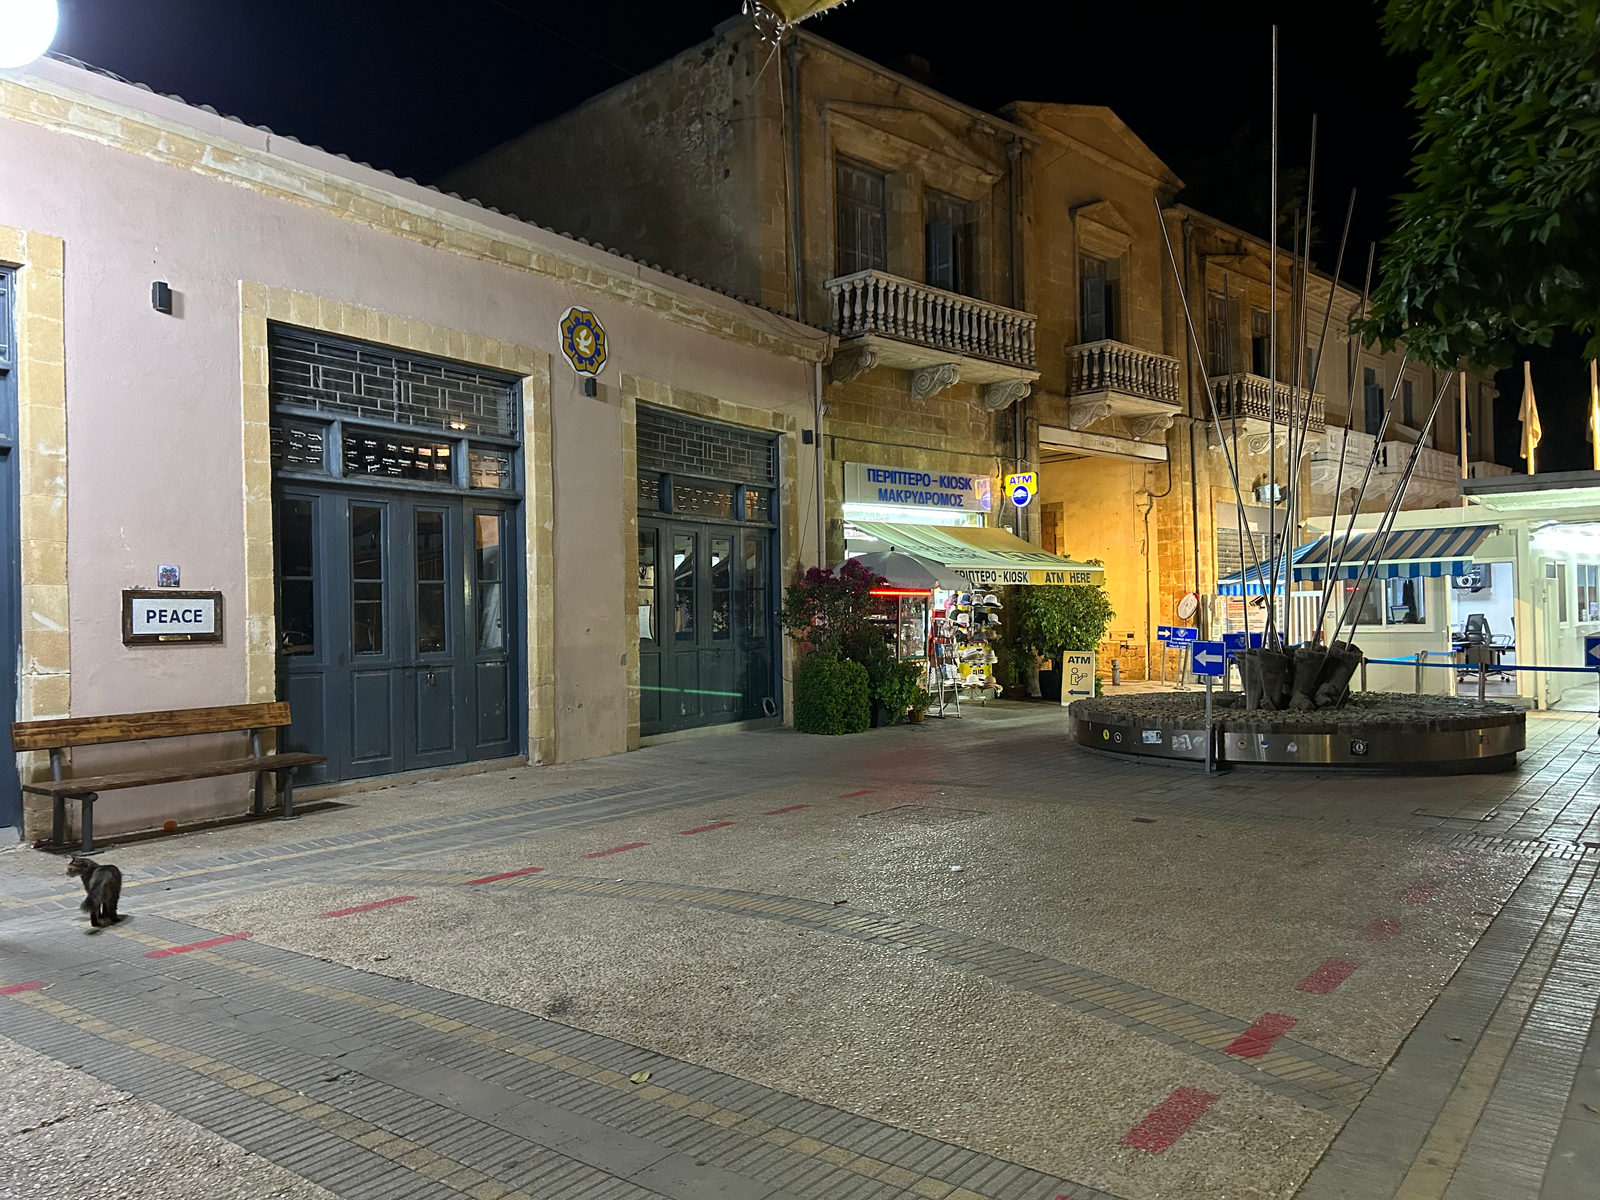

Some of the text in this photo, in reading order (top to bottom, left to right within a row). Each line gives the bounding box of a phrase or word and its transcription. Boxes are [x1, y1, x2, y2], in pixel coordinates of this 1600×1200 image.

[1009, 475, 1032, 485] ATM
[878, 488, 964, 507] ΜΑΚΡΥΔΡΟΜΟΣ
[1003, 570, 1029, 583] KIOSK
[1045, 572, 1091, 583] ATM HERE
[146, 609, 203, 624] PEACE
[1067, 656, 1091, 664] ATM
